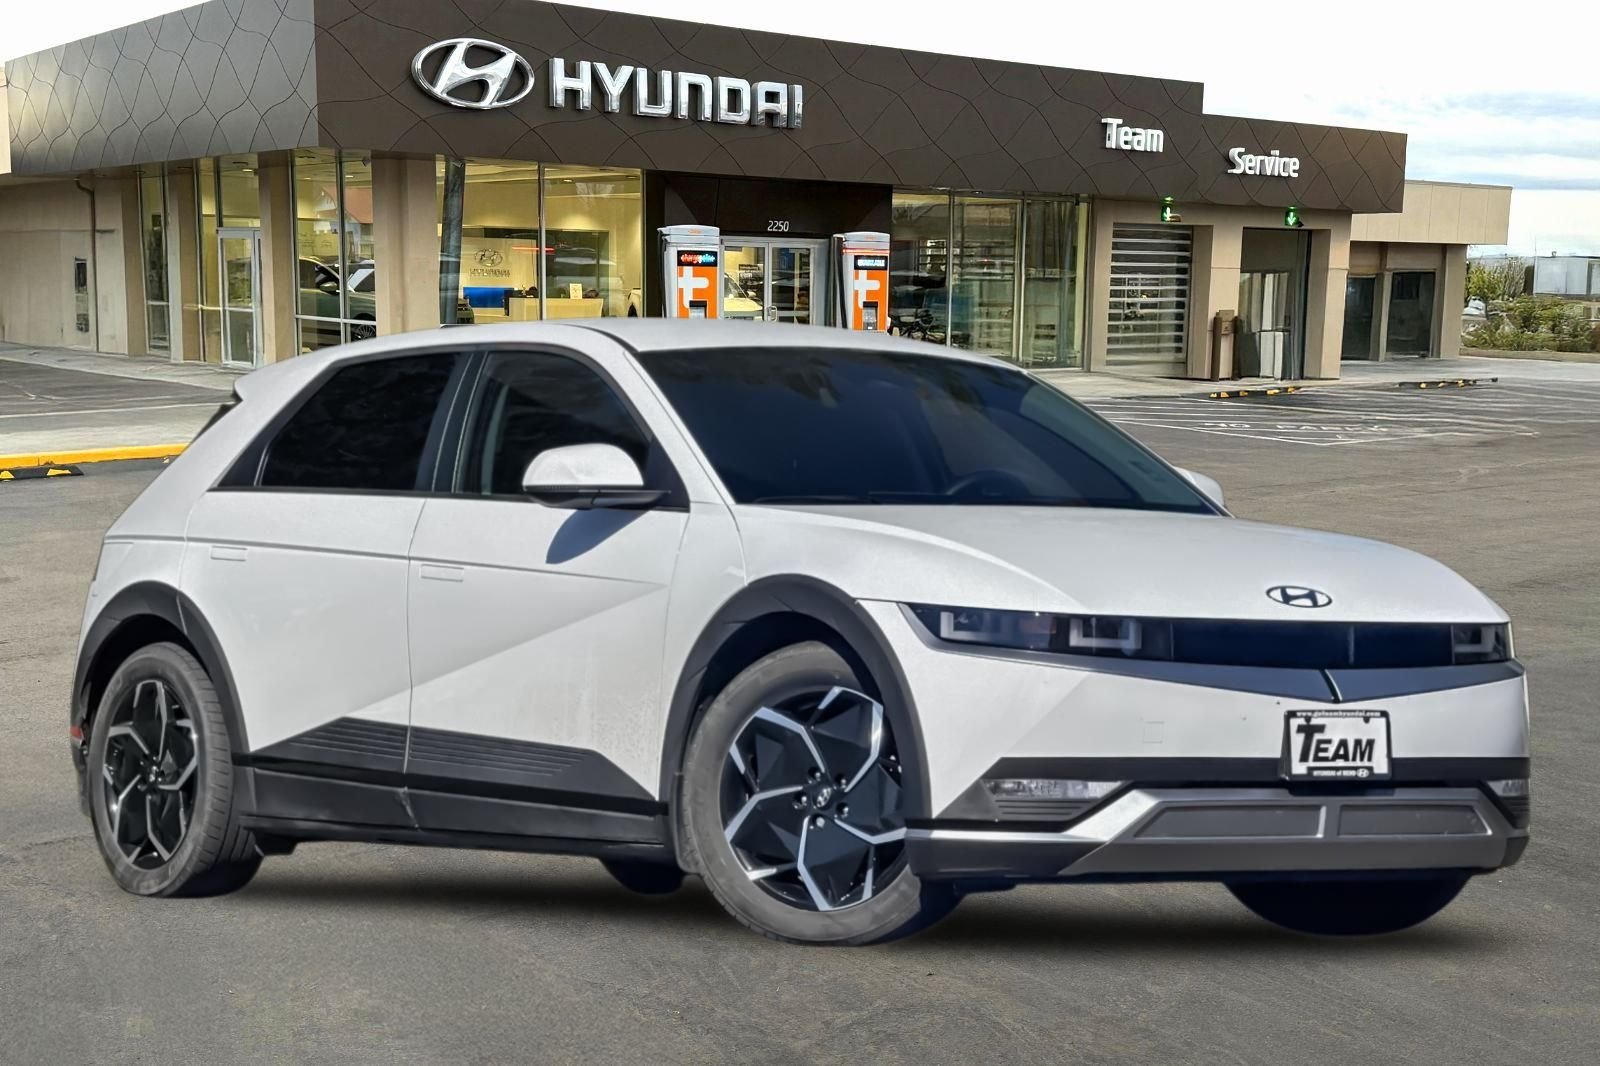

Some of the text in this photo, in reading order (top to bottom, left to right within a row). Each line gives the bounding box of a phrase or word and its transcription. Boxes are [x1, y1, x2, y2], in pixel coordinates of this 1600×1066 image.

[548, 57, 804, 129] HYUNDAI
[1101, 117, 1164, 152] Team
[1227, 147, 1300, 178] Service
[767, 220, 790, 232] 2250
